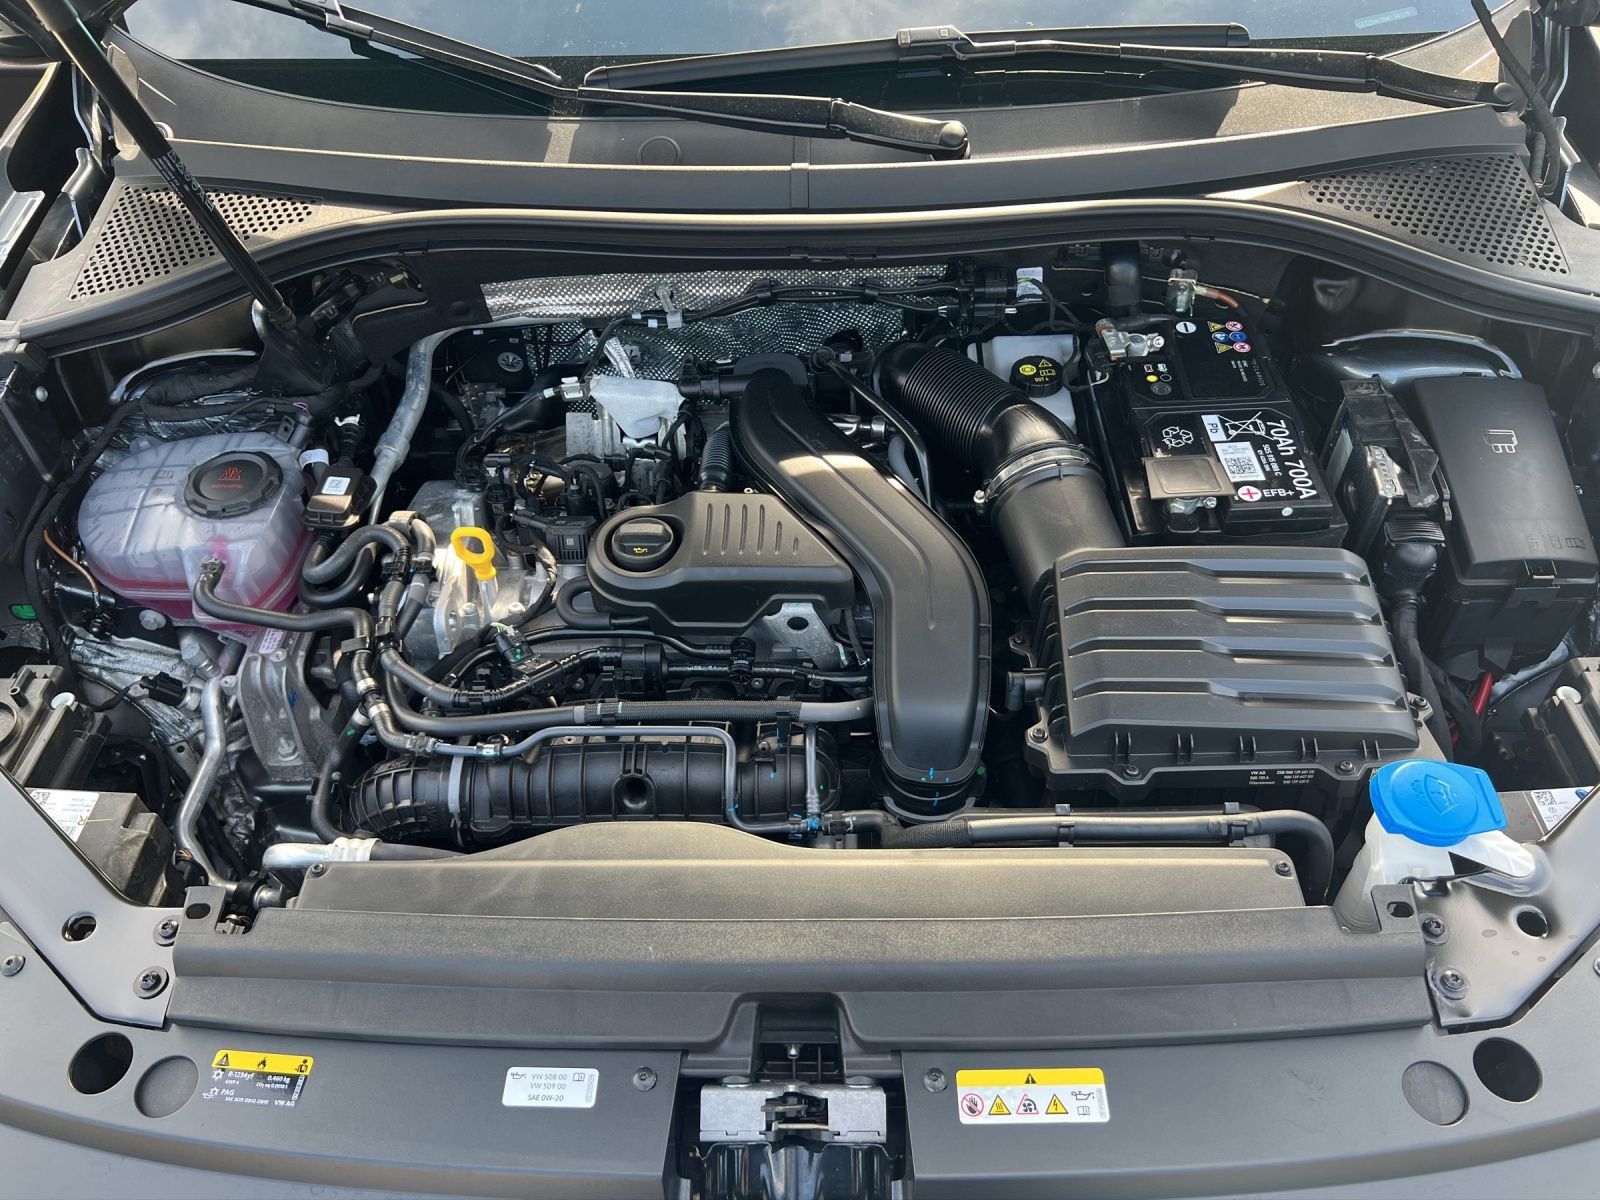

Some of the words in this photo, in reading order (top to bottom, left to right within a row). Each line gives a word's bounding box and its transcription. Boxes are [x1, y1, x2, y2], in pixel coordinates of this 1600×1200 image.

[1207, 422, 1218, 434] Pb
[1266, 419, 1297, 456] 70Ah
[1284, 459, 1318, 500] 700A
[1262, 488, 1294, 498] EFB+
[228, 1071, 255, 1080] R-1234yf
